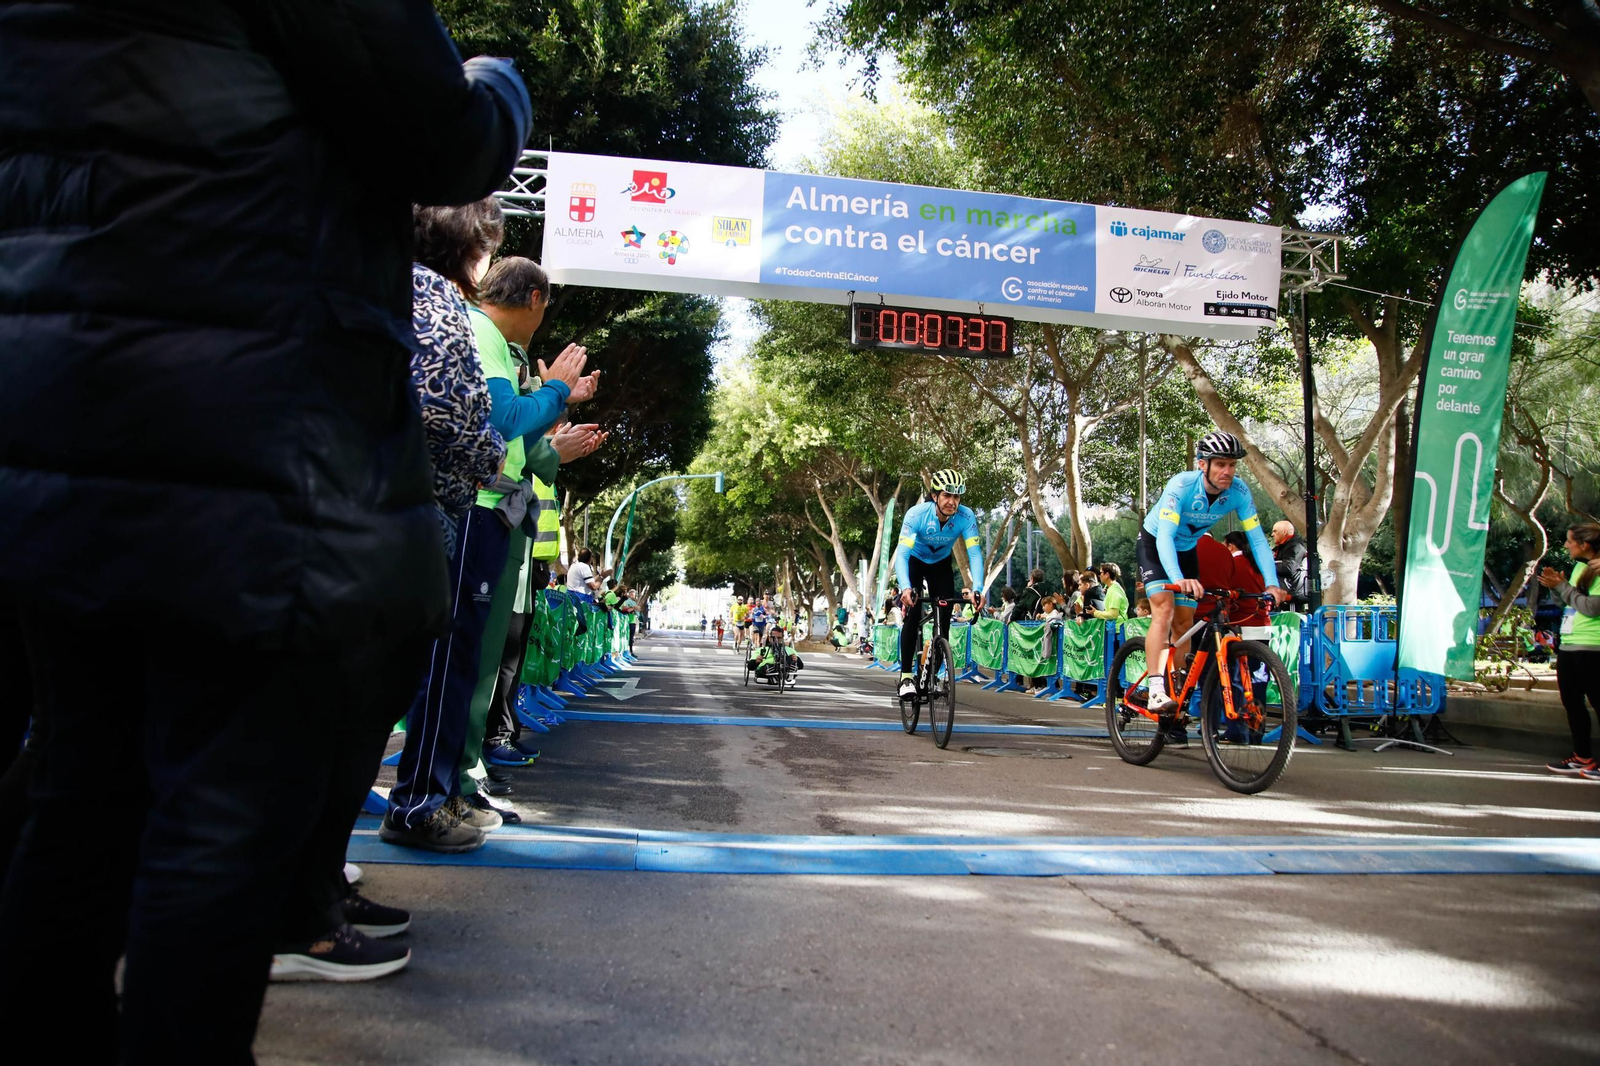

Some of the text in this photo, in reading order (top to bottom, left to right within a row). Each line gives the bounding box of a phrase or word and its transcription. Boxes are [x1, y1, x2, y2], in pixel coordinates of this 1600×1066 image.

[786, 186, 1077, 236] Almería en marcha
[717, 219, 747, 231] SOLAN
[554, 227, 604, 239] ALMERÍA
[1131, 225, 1186, 242] cajamar
[566, 238, 593, 246] CIUDAD
[785, 224, 1041, 265] contra el cáncer
[1227, 236, 1272, 248] UNIVERSIDAD
[774, 267, 880, 283] #TodosContraElCáncer
[1133, 264, 1247, 281] MICHELIN Fundación
[1026, 280, 1089, 292] asociación española
[1136, 288, 1164, 298] Toyota
[1216, 290, 1268, 302] Ejido Motor
[1136, 298, 1192, 311] Alborán Motor
[1447, 330, 1496, 346] Tenemos
[1443, 350, 1484, 364] un gran
[1440, 366, 1481, 380] camino
[1438, 383, 1457, 396] por
[1436, 398, 1480, 414] delante
